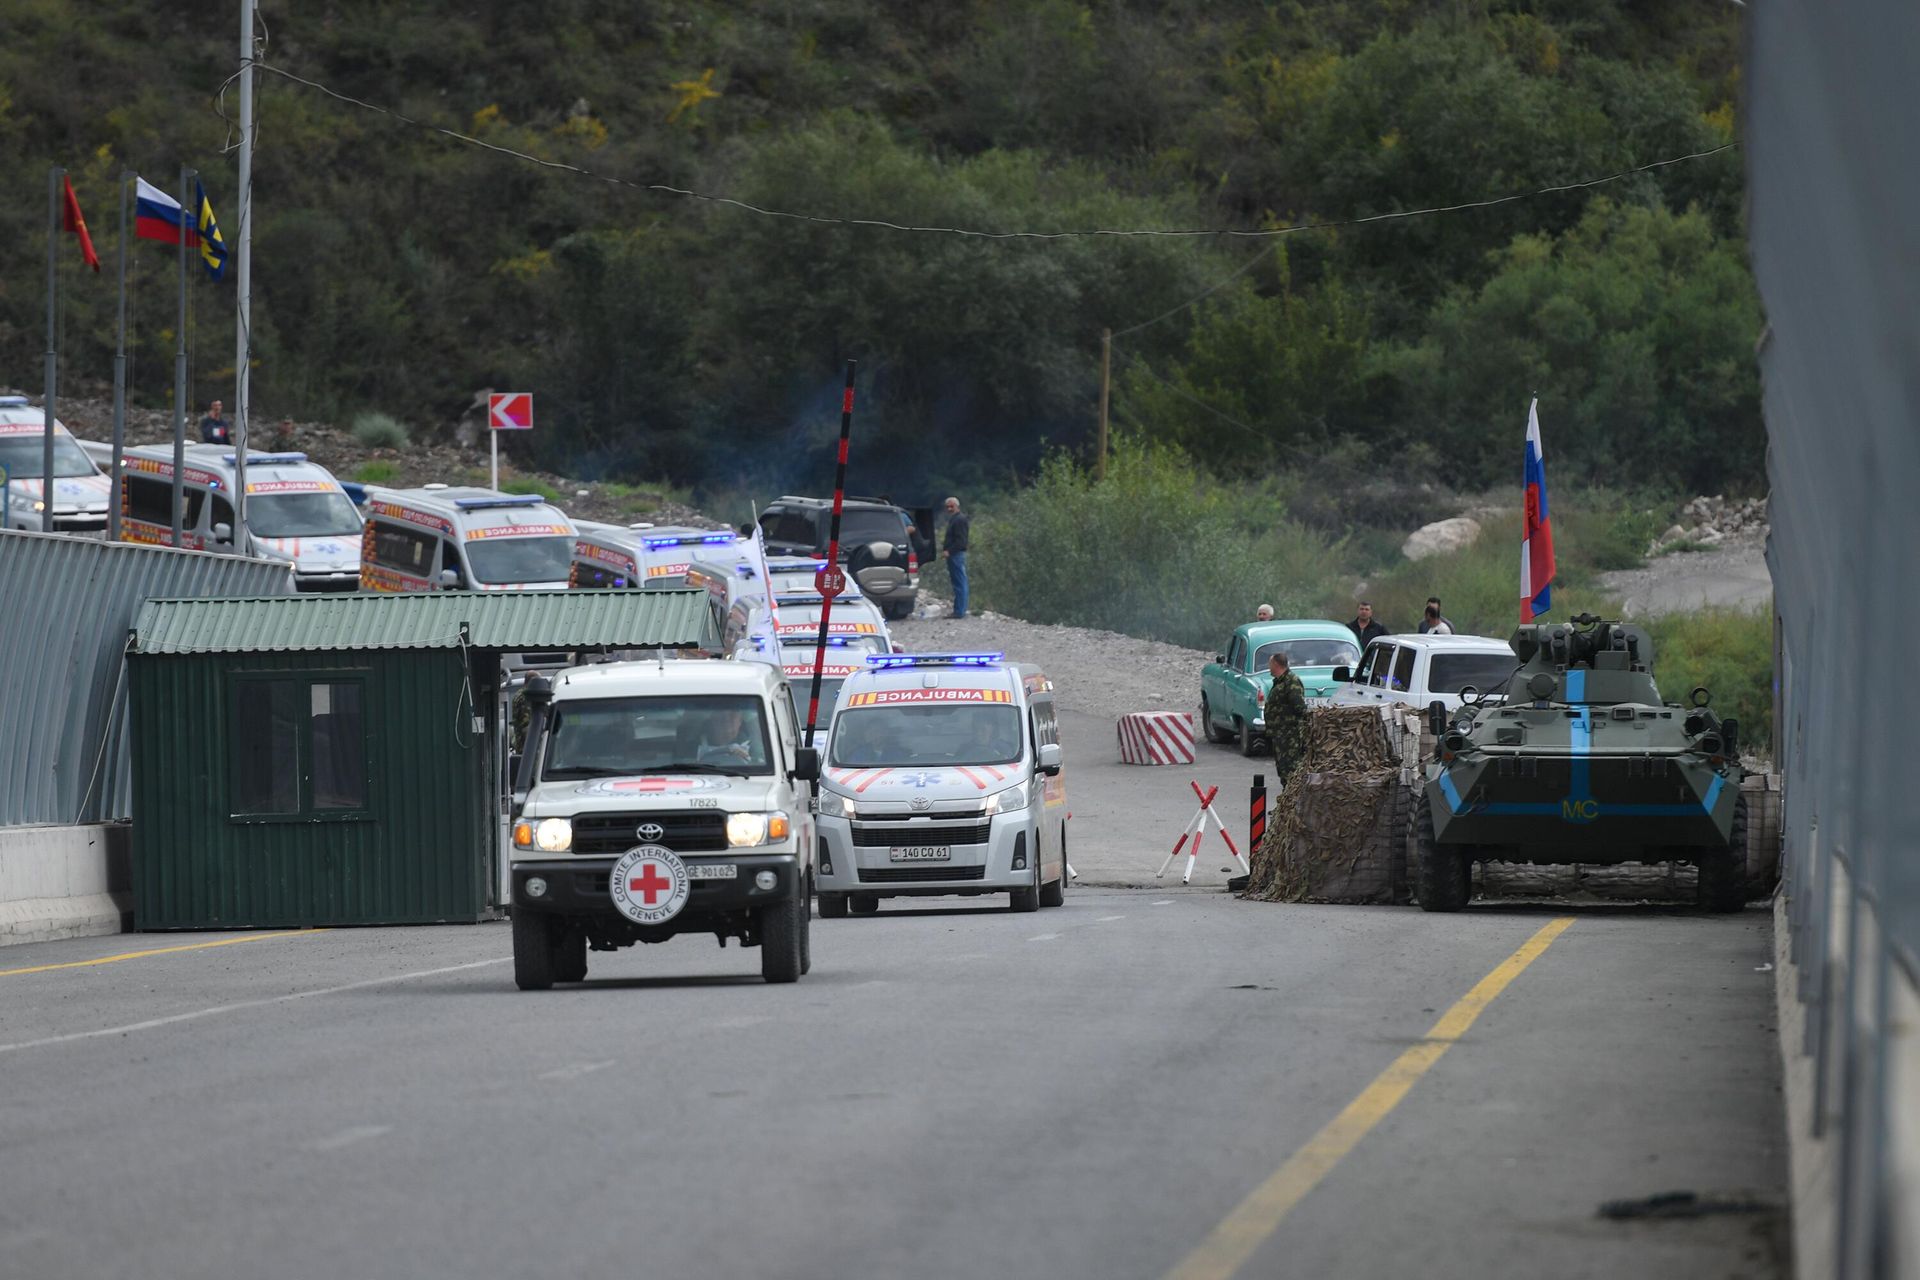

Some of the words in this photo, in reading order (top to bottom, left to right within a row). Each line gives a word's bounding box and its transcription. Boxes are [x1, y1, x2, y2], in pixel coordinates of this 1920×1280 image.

[689, 798, 718, 807] 17823
[902, 847, 919, 858] 140
[936, 847, 947, 857] 61
[614, 861, 630, 903] COMITE
[628, 848, 687, 900] INTERNATIONAL
[629, 905, 674, 921] GENEVE
